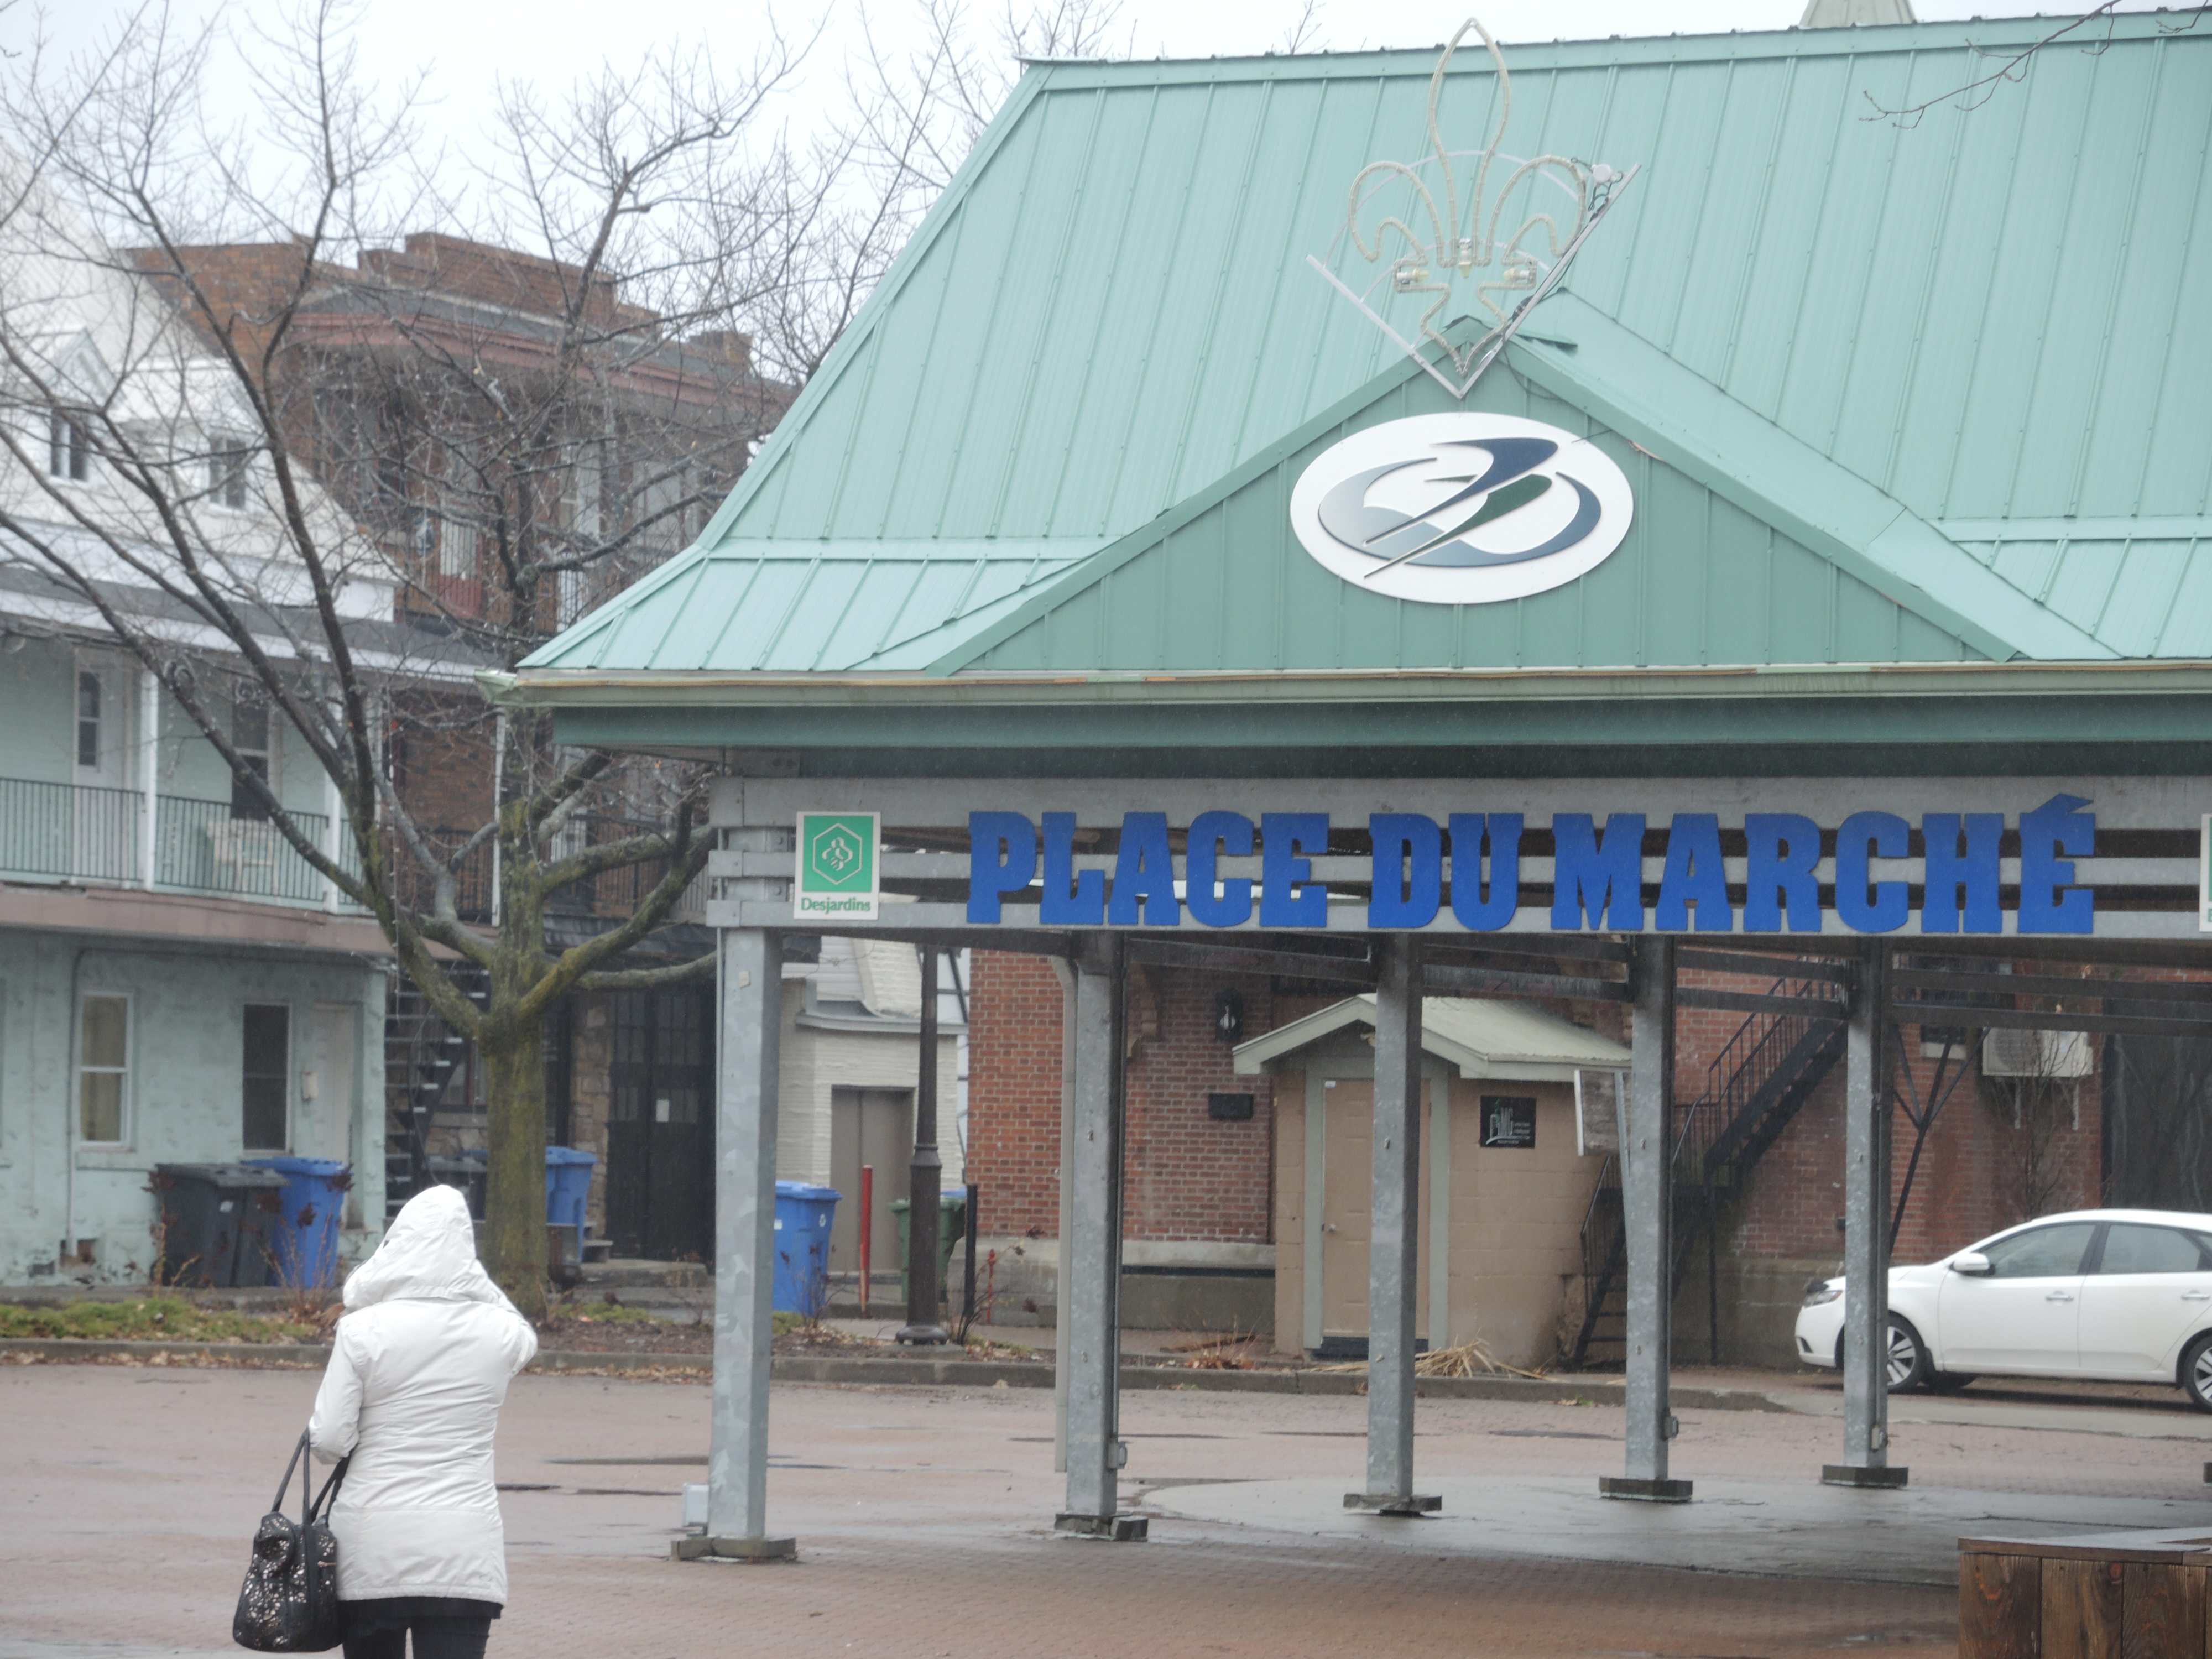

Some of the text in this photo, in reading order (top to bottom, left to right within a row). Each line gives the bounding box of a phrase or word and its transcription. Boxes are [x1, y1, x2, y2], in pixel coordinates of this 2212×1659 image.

[967, 792, 2095, 933] PLACE DU MARCHÉ
[801, 896, 870, 914] Desjardins
